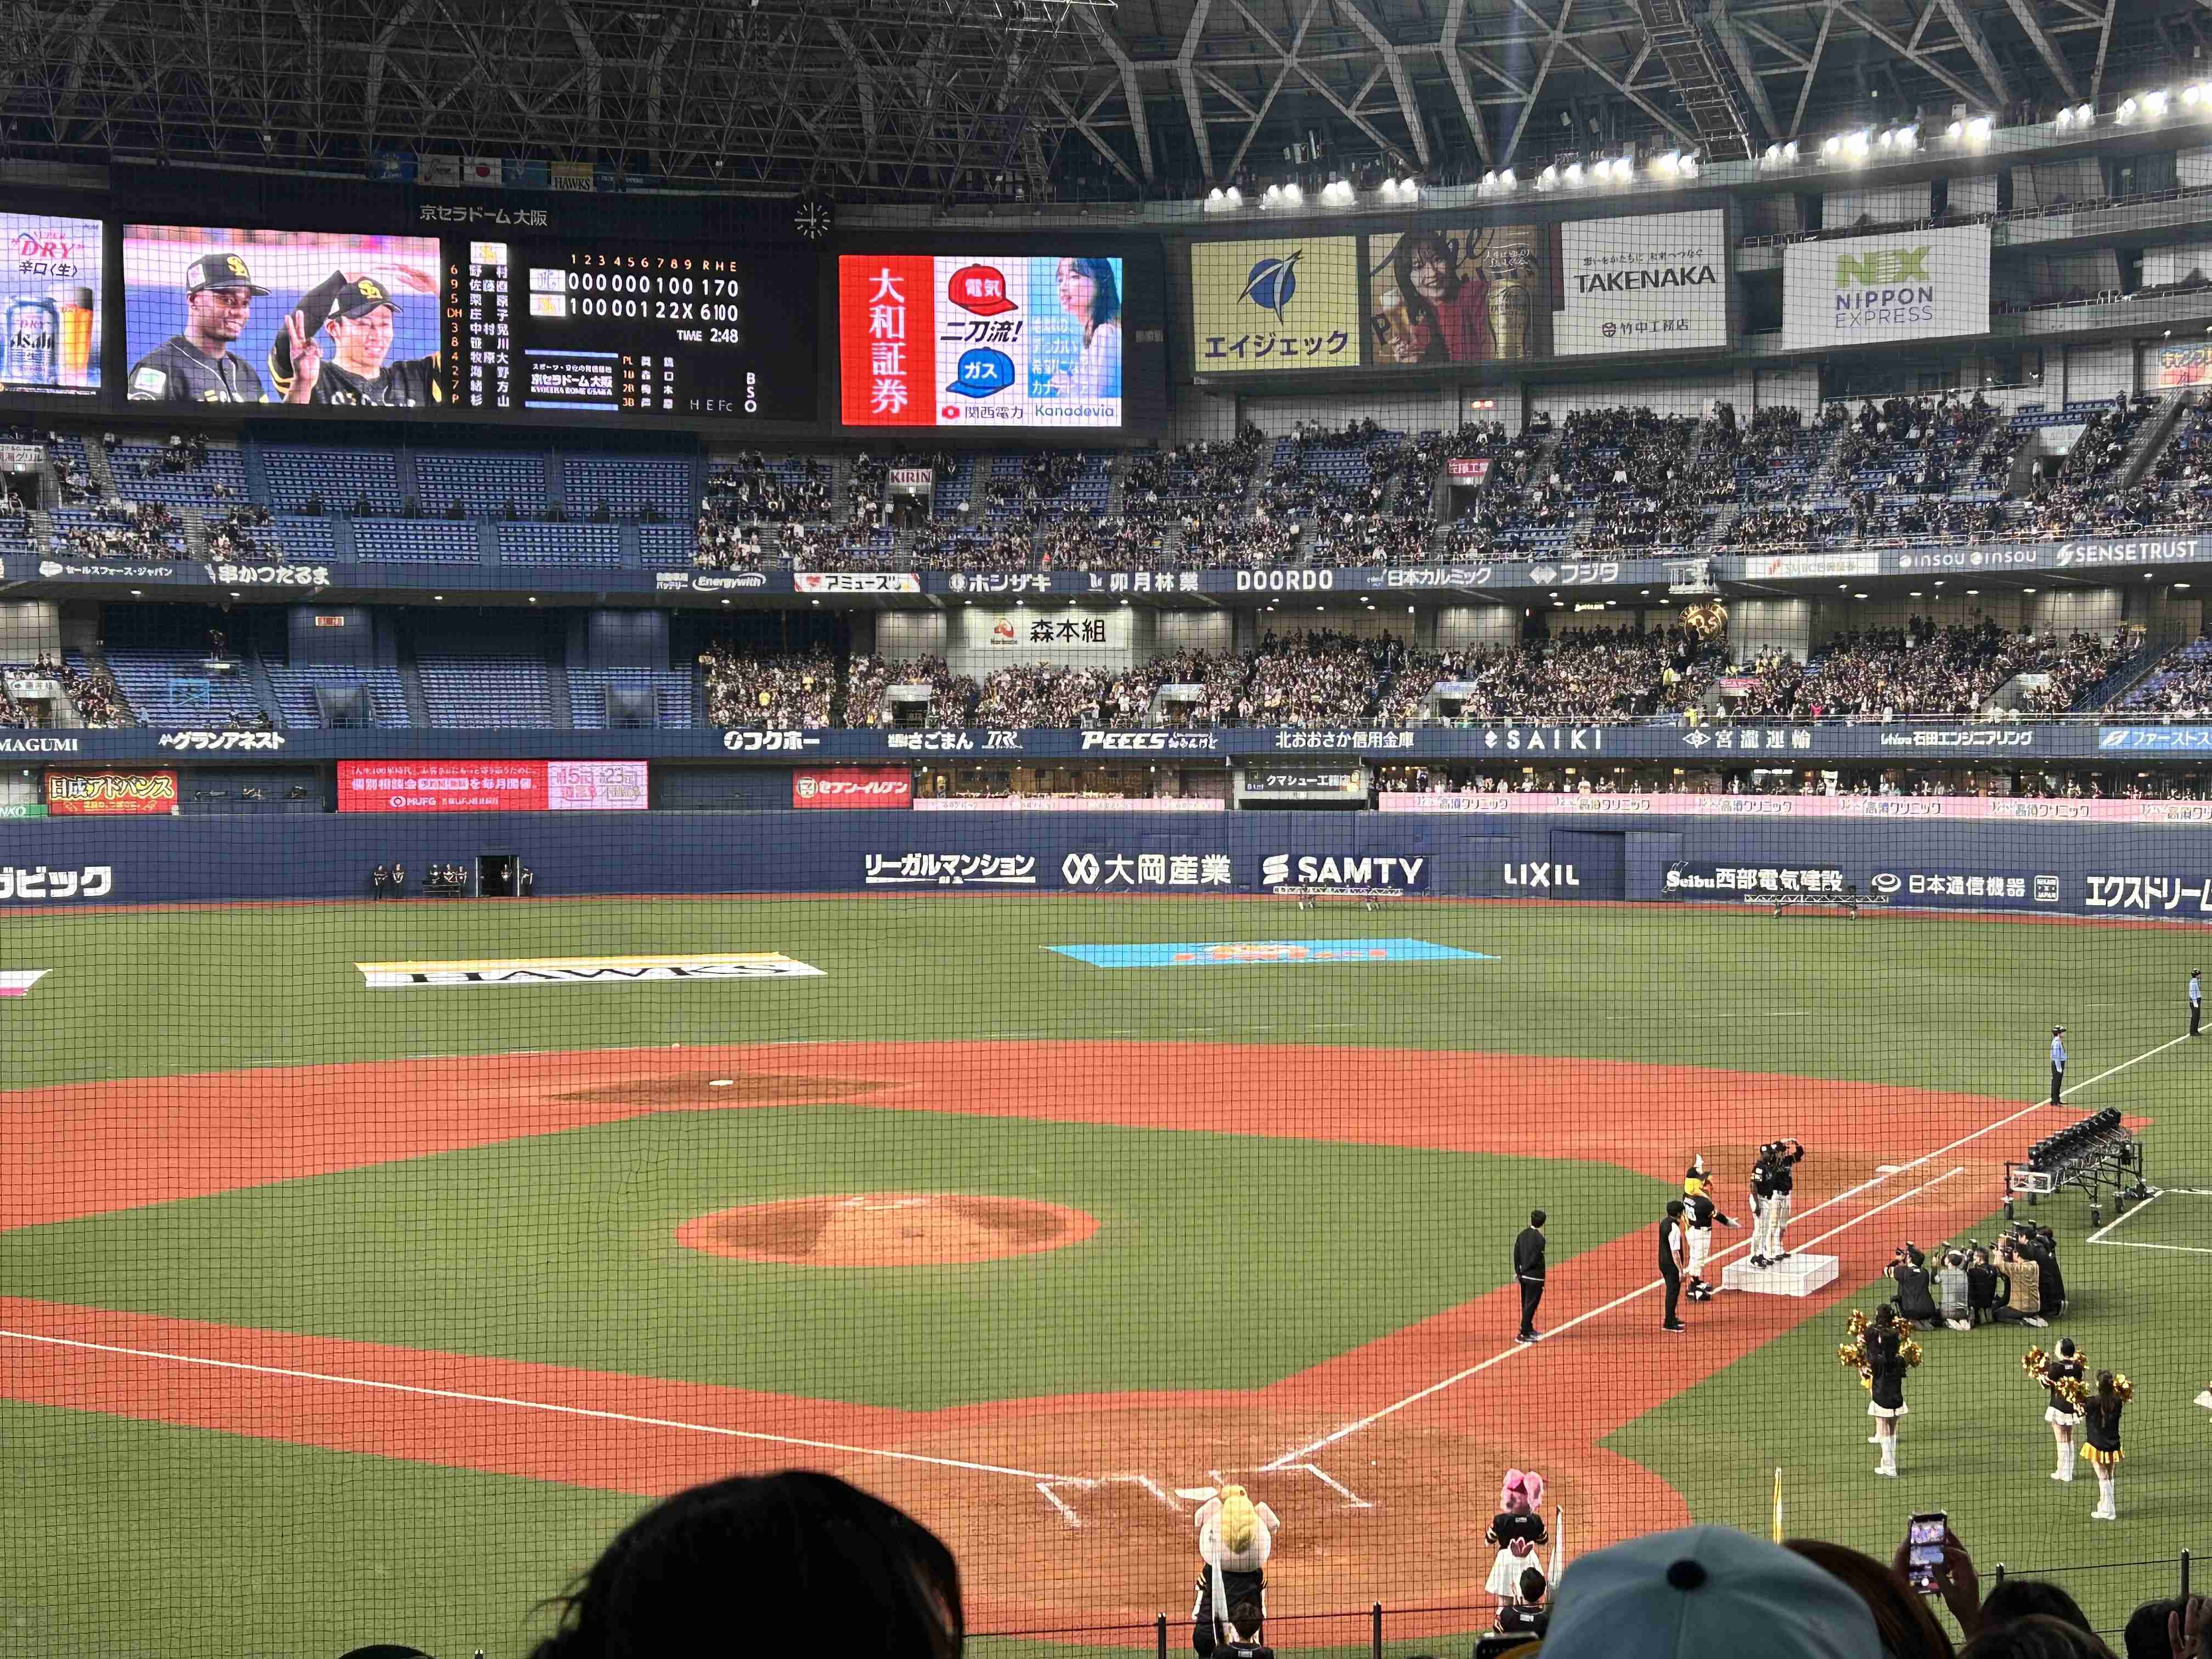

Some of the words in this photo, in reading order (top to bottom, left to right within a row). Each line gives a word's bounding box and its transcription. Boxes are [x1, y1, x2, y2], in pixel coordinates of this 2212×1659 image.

[553, 176, 591, 191] HAWKS
[420, 204, 547, 226] 京セラドーム大阪
[21, 240, 70, 259] DRY
[451, 264, 458, 274] 6
[451, 279, 458, 289] 9
[965, 278, 1001, 298] 電気
[1573, 266, 1716, 293] TAKENAKA
[451, 294, 458, 303] 5
[1836, 286, 1934, 310] NIPPON
[447, 307, 462, 318] DH
[1835, 306, 1933, 329] EXPRESS
[452, 323, 458, 332] 3
[677, 330, 702, 341] TIME
[710, 328, 738, 343] 2:48
[1620, 319, 1689, 335] 竹中工務店
[452, 336, 459, 346] 8
[869, 268, 908, 414] 大和証券
[1205, 330, 1348, 358] エイジェック
[452, 352, 458, 360] 4
[452, 365, 459, 375] 2
[746, 372, 755, 385] B
[964, 362, 998, 379] ガス
[452, 380, 459, 389] 7
[746, 386, 755, 398] S
[453, 394, 459, 403] P
[471, 394, 509, 407] 杉山
[690, 399, 699, 410] H
[707, 399, 714, 410] E
[965, 405, 1023, 419] 関西電力
[890, 469, 932, 484] KIRIN
[1914, 553, 1965, 567] insou
[1984, 550, 2036, 564] insou
[218, 563, 330, 585] 串かつだるま
[698, 576, 761, 588] Energywith
[825, 575, 895, 590] アミューズ
[969, 573, 1052, 592] ホシザキ
[1110, 572, 1199, 592] 卯月林業
[1237, 569, 1333, 591] DOORDO
[1387, 568, 1492, 586] 日本カルミック
[1561, 563, 1618, 584] フジタ
[1030, 618, 1106, 643] 森本組
[173, 731, 285, 750] グランアネスト
[742, 731, 820, 751] フクホー
[1081, 731, 1169, 749] PEEES
[1275, 731, 1414, 749] 北おおさか信用金庫
[1506, 730, 1601, 750] SAIKI
[1913, 731, 2033, 746] 石田エンジニアリング
[407, 797, 436, 805] MUFG
[866, 853, 1035, 876] リーガルマンション
[1105, 854, 1231, 885] 大岡産業
[1298, 856, 1423, 884] SAMTY
[1504, 862, 1579, 886] LIXIL
[1716, 868, 1842, 891] 西部電気建設
[1909, 874, 2025, 898] 日本通信機器
[410, 964, 792, 983] HAWKS
